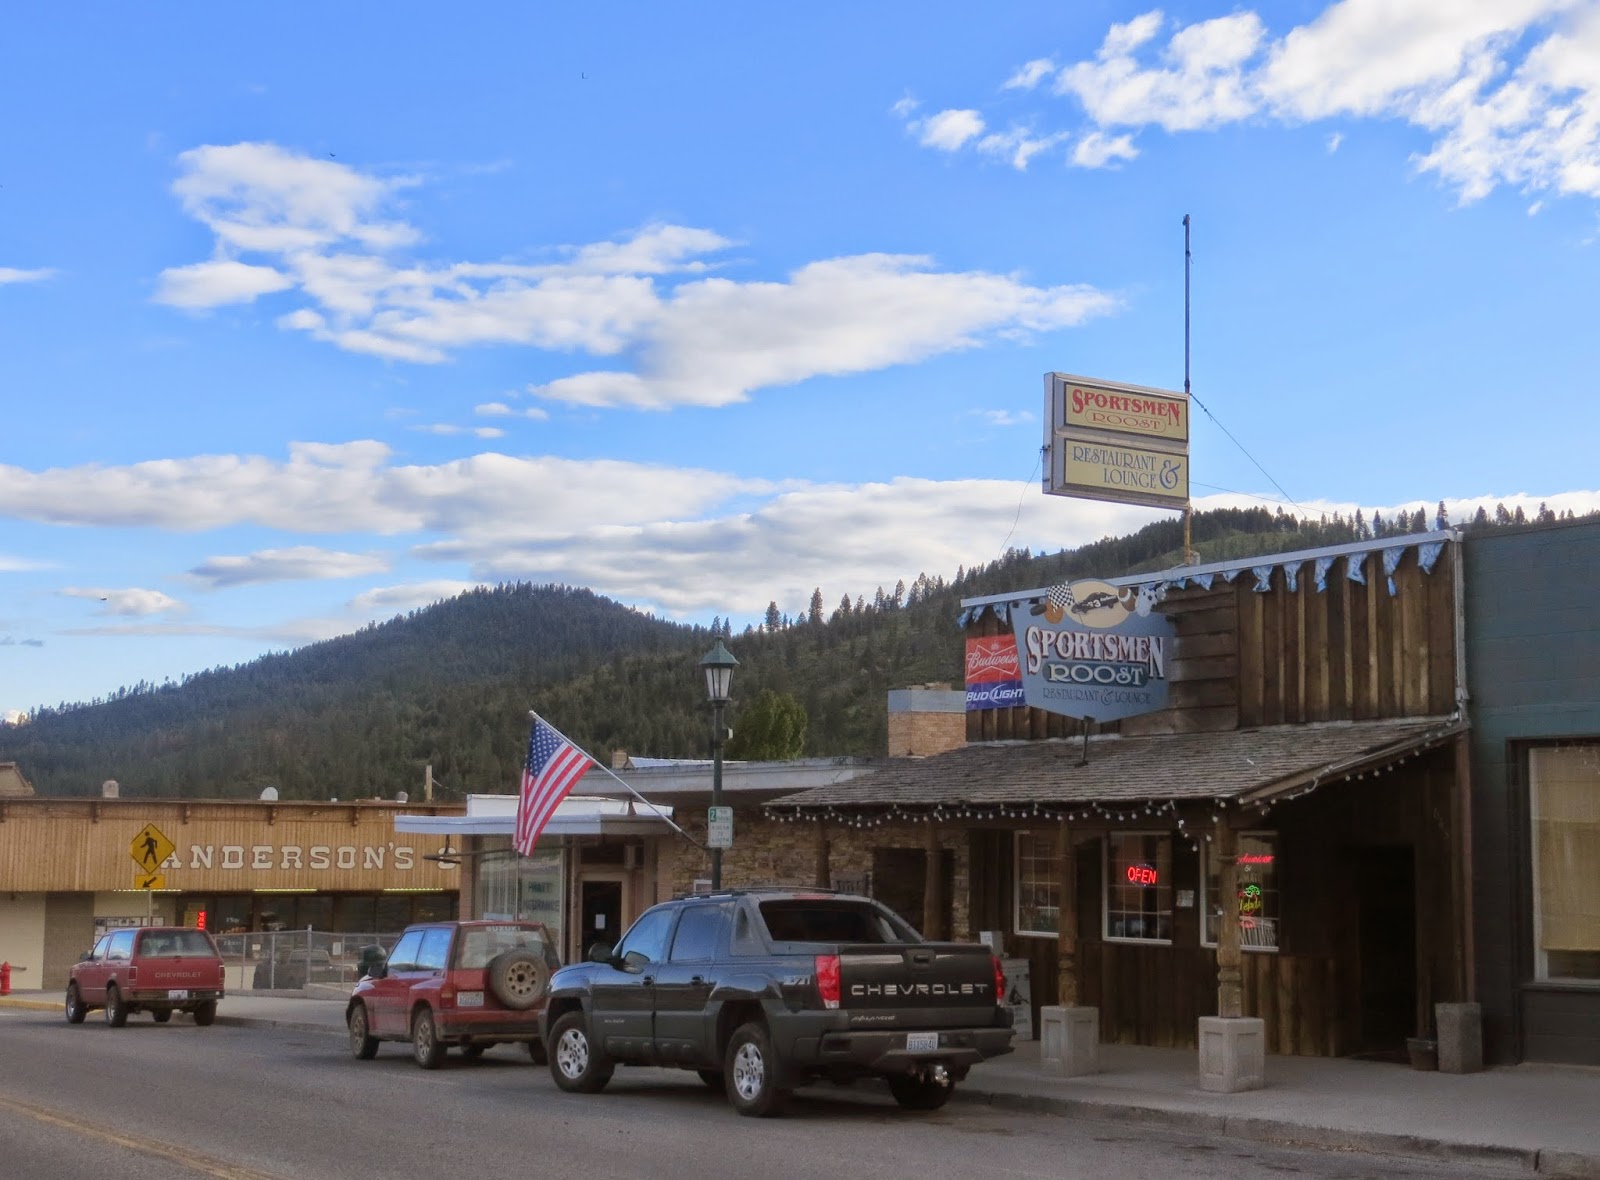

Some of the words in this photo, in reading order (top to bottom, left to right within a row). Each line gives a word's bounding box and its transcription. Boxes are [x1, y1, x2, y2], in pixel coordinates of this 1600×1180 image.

[1072, 388, 1180, 426] SPORTSMEN
[1092, 412, 1160, 429] ROOST
[1072, 446, 1156, 472] RESTAURANT
[1159, 460, 1181, 490] &
[1104, 468, 1156, 489] LOUNGE
[966, 650, 1018, 668] Budweise
[1026, 625, 1164, 680] SPORTSMEN
[1048, 663, 1144, 686] ROOST
[966, 690, 988, 702] BUD
[994, 688, 1024, 700] LIGHT
[1042, 687, 1099, 702] RESTAURANT
[1100, 688, 1114, 704] &
[1114, 692, 1152, 704] LOUNGE
[710, 809, 716, 822] 2
[160, 842, 414, 870] ANDERSON'S
[1127, 866, 1157, 884] OPEN
[851, 982, 989, 996] CHEVROLET
